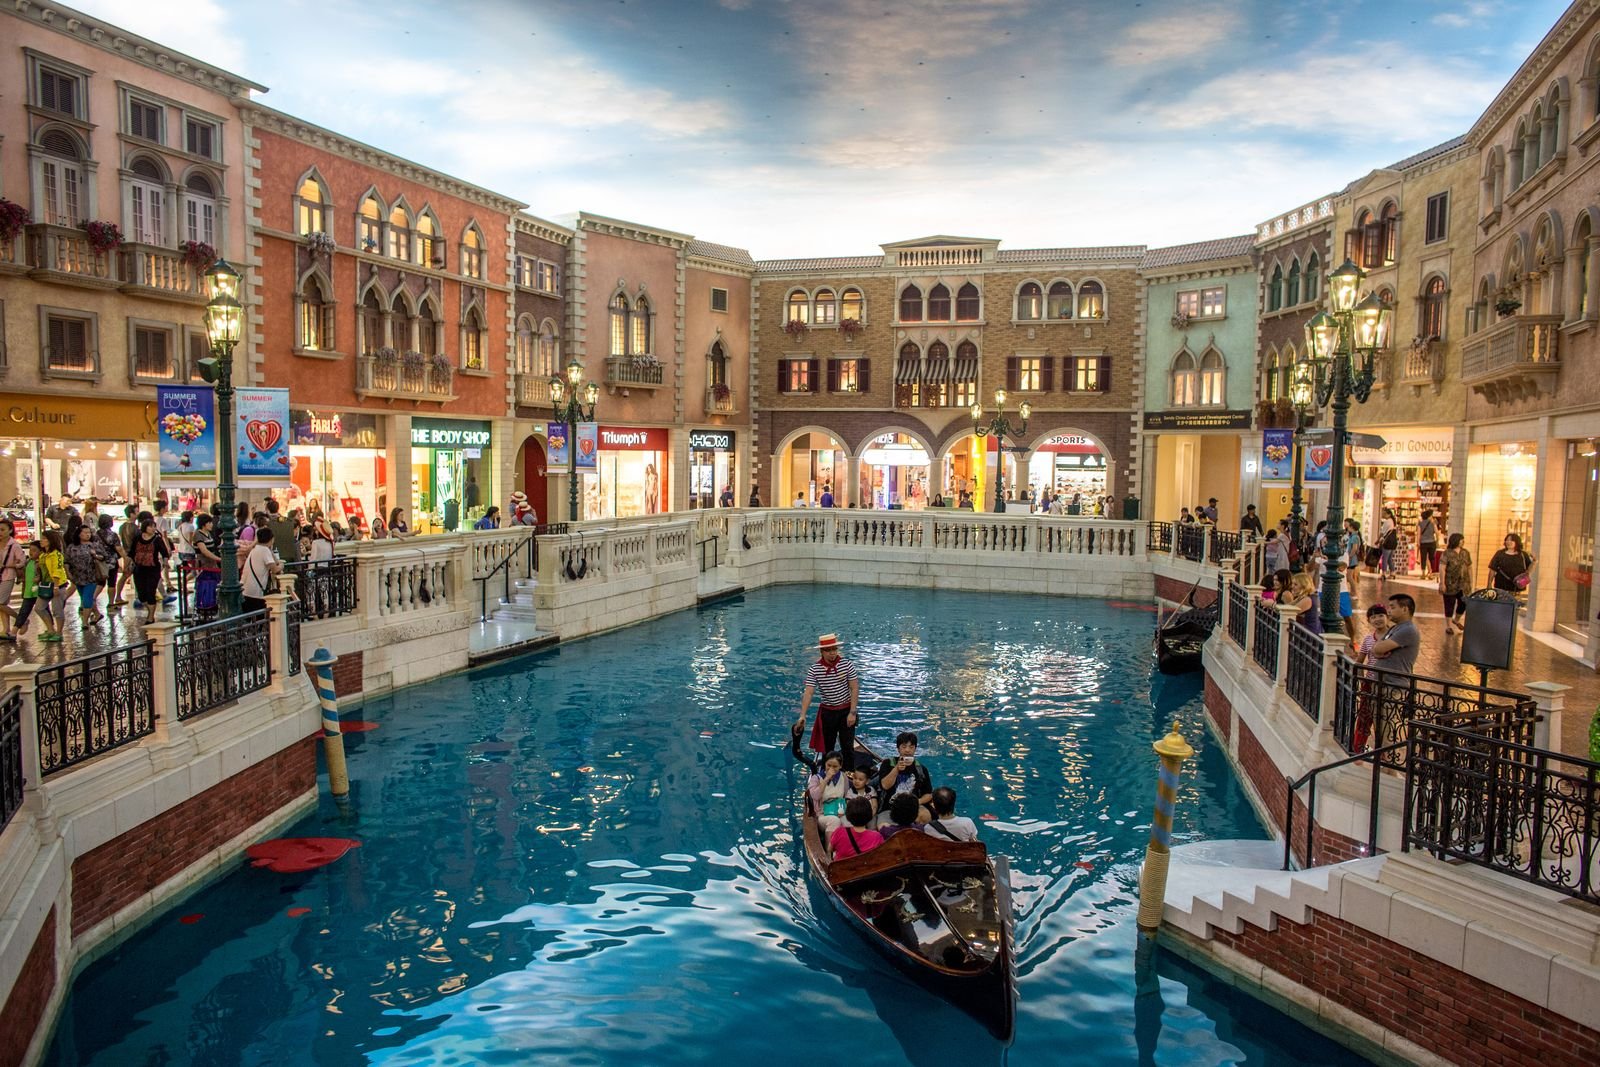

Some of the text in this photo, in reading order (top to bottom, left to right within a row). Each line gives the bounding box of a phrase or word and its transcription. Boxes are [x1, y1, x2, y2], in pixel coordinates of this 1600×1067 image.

[163, 392, 197, 400] SUMMER
[163, 398, 197, 409] LOVE
[411, 428, 430, 443] THE
[431, 429, 462, 444] BODY
[601, 431, 640, 447] Triumph
[1050, 436, 1086, 444] SPORTS
[1395, 442, 1405, 452] DI
[1407, 439, 1452, 453] GONDOLA
[1568, 535, 1594, 567] SALE
